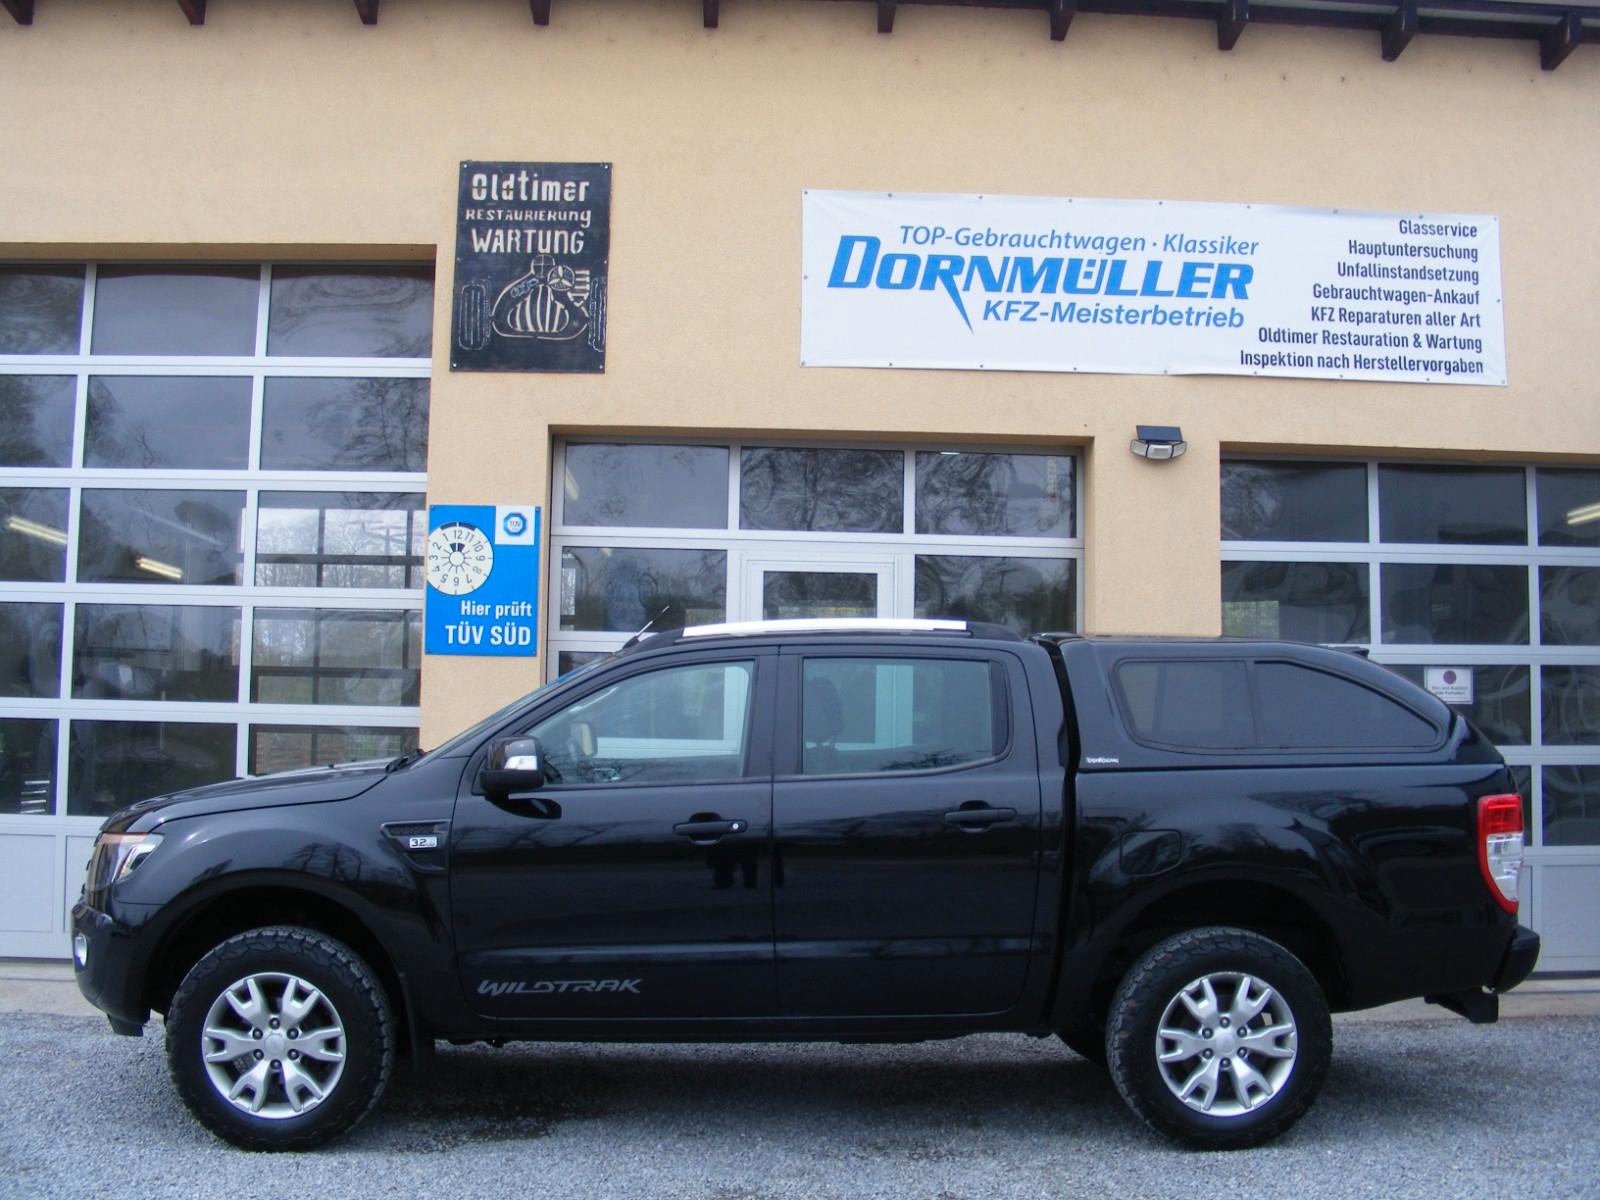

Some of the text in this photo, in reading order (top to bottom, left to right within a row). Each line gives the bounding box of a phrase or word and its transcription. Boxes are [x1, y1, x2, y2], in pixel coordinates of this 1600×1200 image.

[471, 169, 590, 202] Oldtimer
[900, 225, 1259, 256] TOP-Gebrauchtwagen Klassiker
[1399, 220, 1478, 237] Glasservice
[1348, 239, 1479, 263] Hauptuntersuchung
[827, 235, 1255, 335] DORNMÜLLER
[1337, 261, 1480, 285] Unfallinstandsetzung
[1312, 283, 1481, 306] Gebrauchtwagen-Ankauf
[982, 300, 1246, 328] KFZ-Meisterbetrieb
[1311, 306, 1482, 328] KFZ Reparaturen aller Art
[1258, 327, 1483, 353] Oldtimer Restauration & Wartung
[1240, 350, 1484, 376] Inspektion nach Herstellervorgaben
[453, 529, 463, 540] 12
[460, 600, 532, 619] Hier prüft
[445, 621, 531, 646] TÜV SÜD
[477, 978, 643, 997] WILDTRAK
